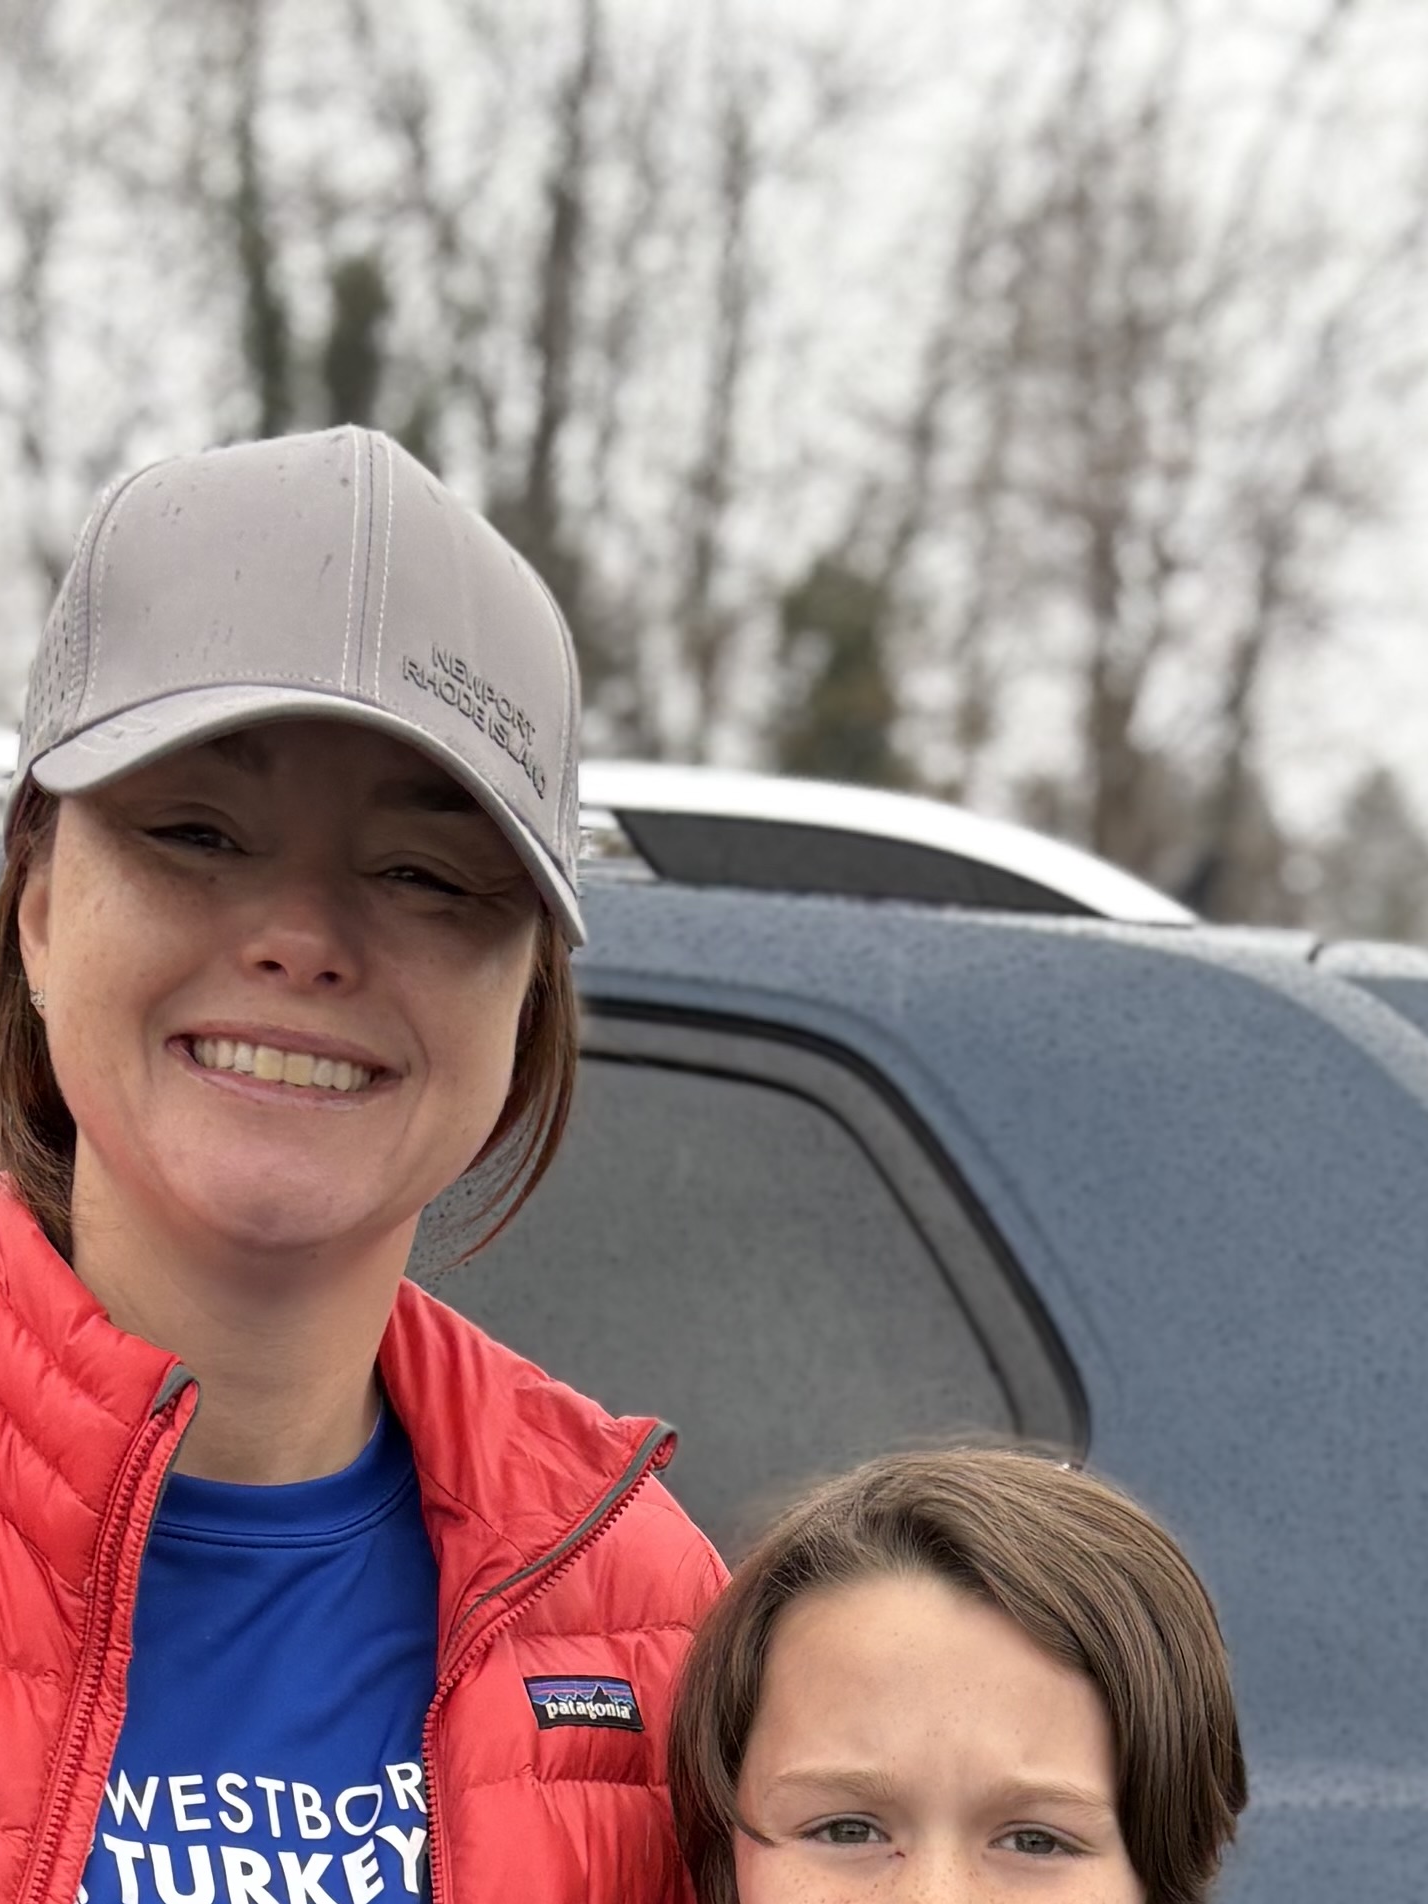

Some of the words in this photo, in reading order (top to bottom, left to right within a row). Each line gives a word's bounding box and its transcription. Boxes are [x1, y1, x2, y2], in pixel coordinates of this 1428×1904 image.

[402, 655, 485, 732] RHODE
[489, 717, 546, 800] ISLAND
[430, 642, 536, 746] NEWPORT
[545, 1700, 632, 1720] patagonia
